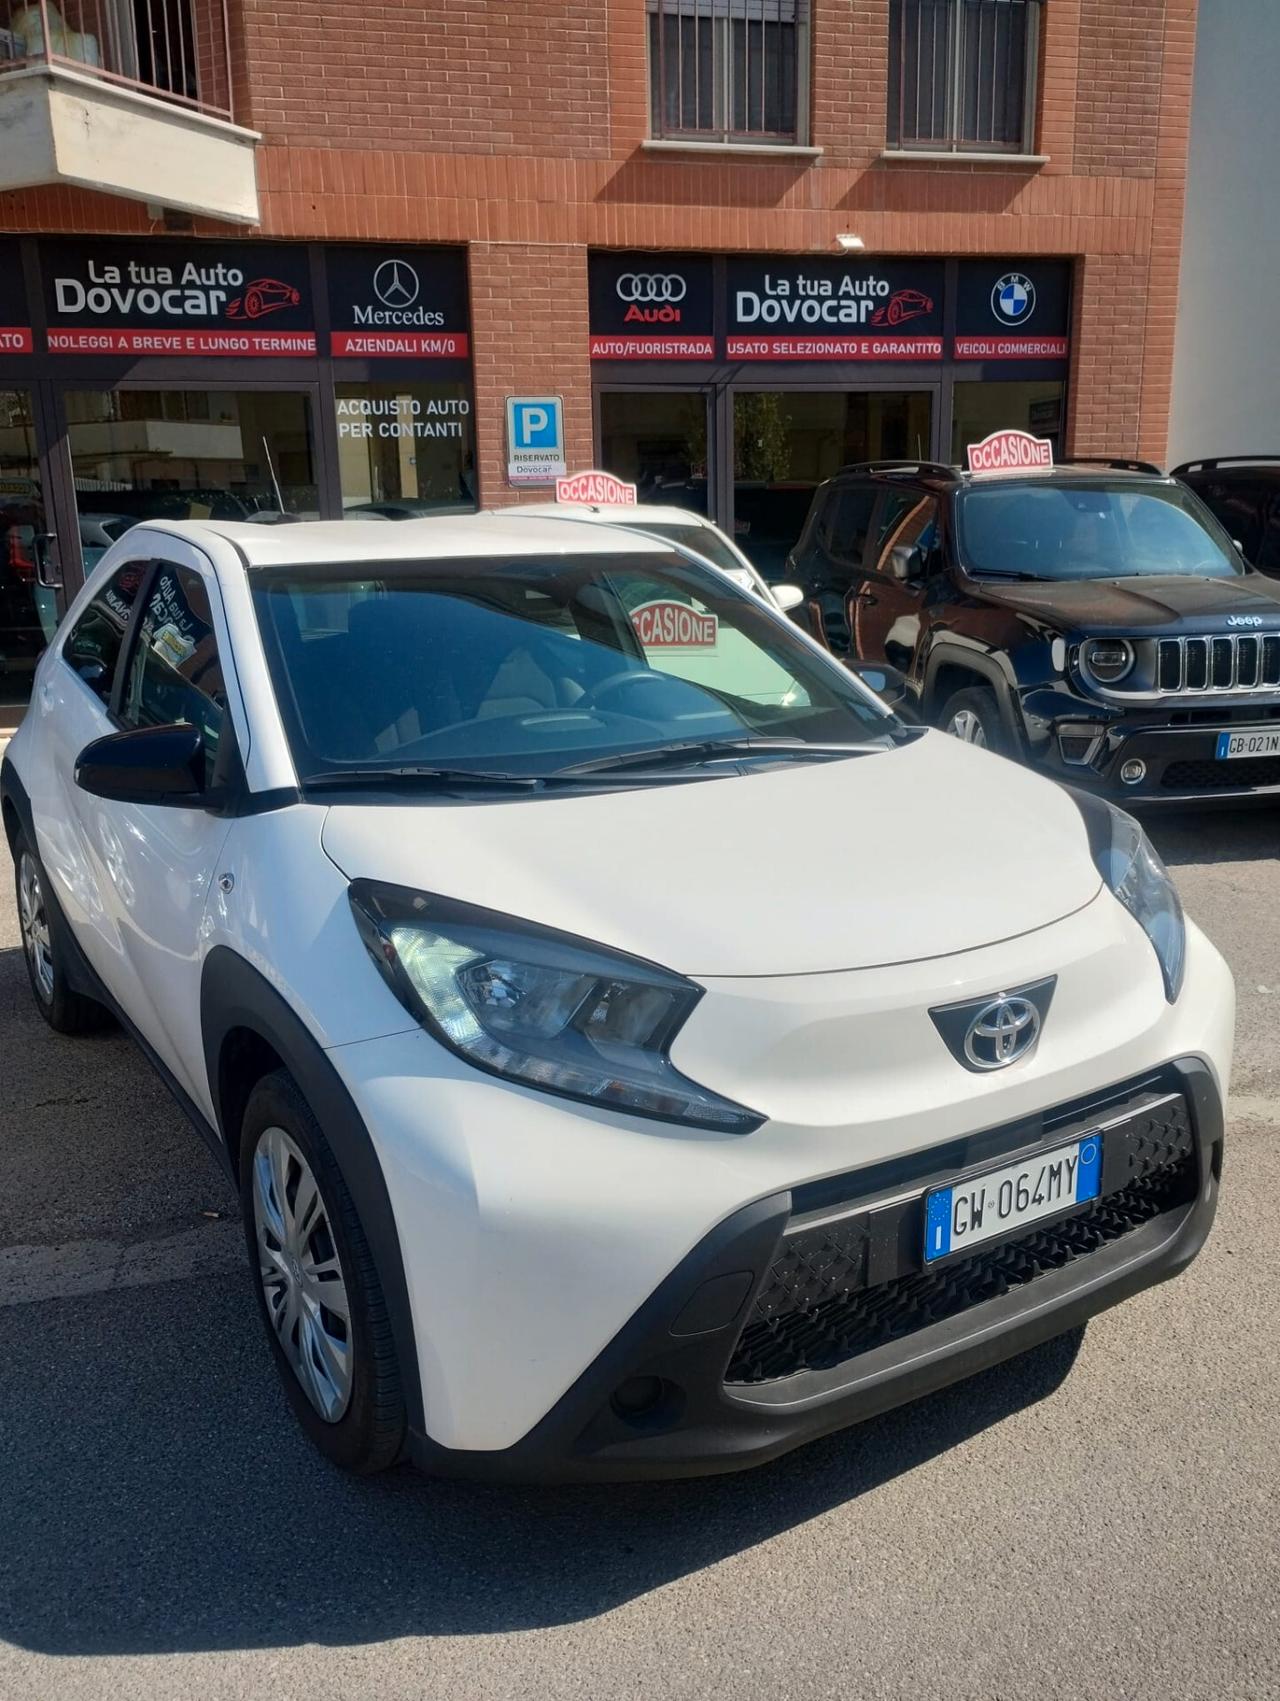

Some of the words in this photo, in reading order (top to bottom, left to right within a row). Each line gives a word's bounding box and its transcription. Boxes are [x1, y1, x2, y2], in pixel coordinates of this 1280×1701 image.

[88, 260, 120, 284] La
[128, 261, 173, 284] tua
[181, 262, 243, 286] Auto
[765, 274, 790, 296] La
[796, 274, 832, 296] tua
[838, 275, 890, 297] Auto
[55, 278, 227, 315] Dovocar
[352, 305, 445, 326] Mercedes
[624, 304, 681, 322] Audi
[736, 291, 874, 323] Dovocar
[48, 336, 113, 348] NOLEGGI
[118, 336, 128, 348] A
[133, 337, 181, 349] BREVE
[186, 338, 195, 350] E
[200, 338, 249, 350] LUNGO
[252, 338, 317, 351] TERMINE
[345, 339, 417, 352] AZIENDALI
[592, 342, 713, 356] AUTO/FUORISTRADA
[727, 343, 769, 354] USATO
[772, 343, 857, 354] SELEZIONATO
[861, 343, 869, 354] E
[872, 343, 942, 354] GARANTITO
[956, 343, 995, 355] VEICOLI
[998, 343, 1066, 355] COMMERCIALI
[337, 400, 421, 416] ACQUISTO
[426, 400, 470, 415] AUTO
[340, 422, 373, 438] PER
[378, 422, 463, 437] CONTANTI
[522, 407, 548, 444] P
[513, 454, 560, 462] RISERVATO
[972, 436, 1050, 470] OCCASIONE
[560, 476, 634, 505] OCCASIONE
[1227, 615, 1263, 627] Jeep
[954, 1190, 986, 1236] GW
[999, 1156, 1078, 1219] 064MY
